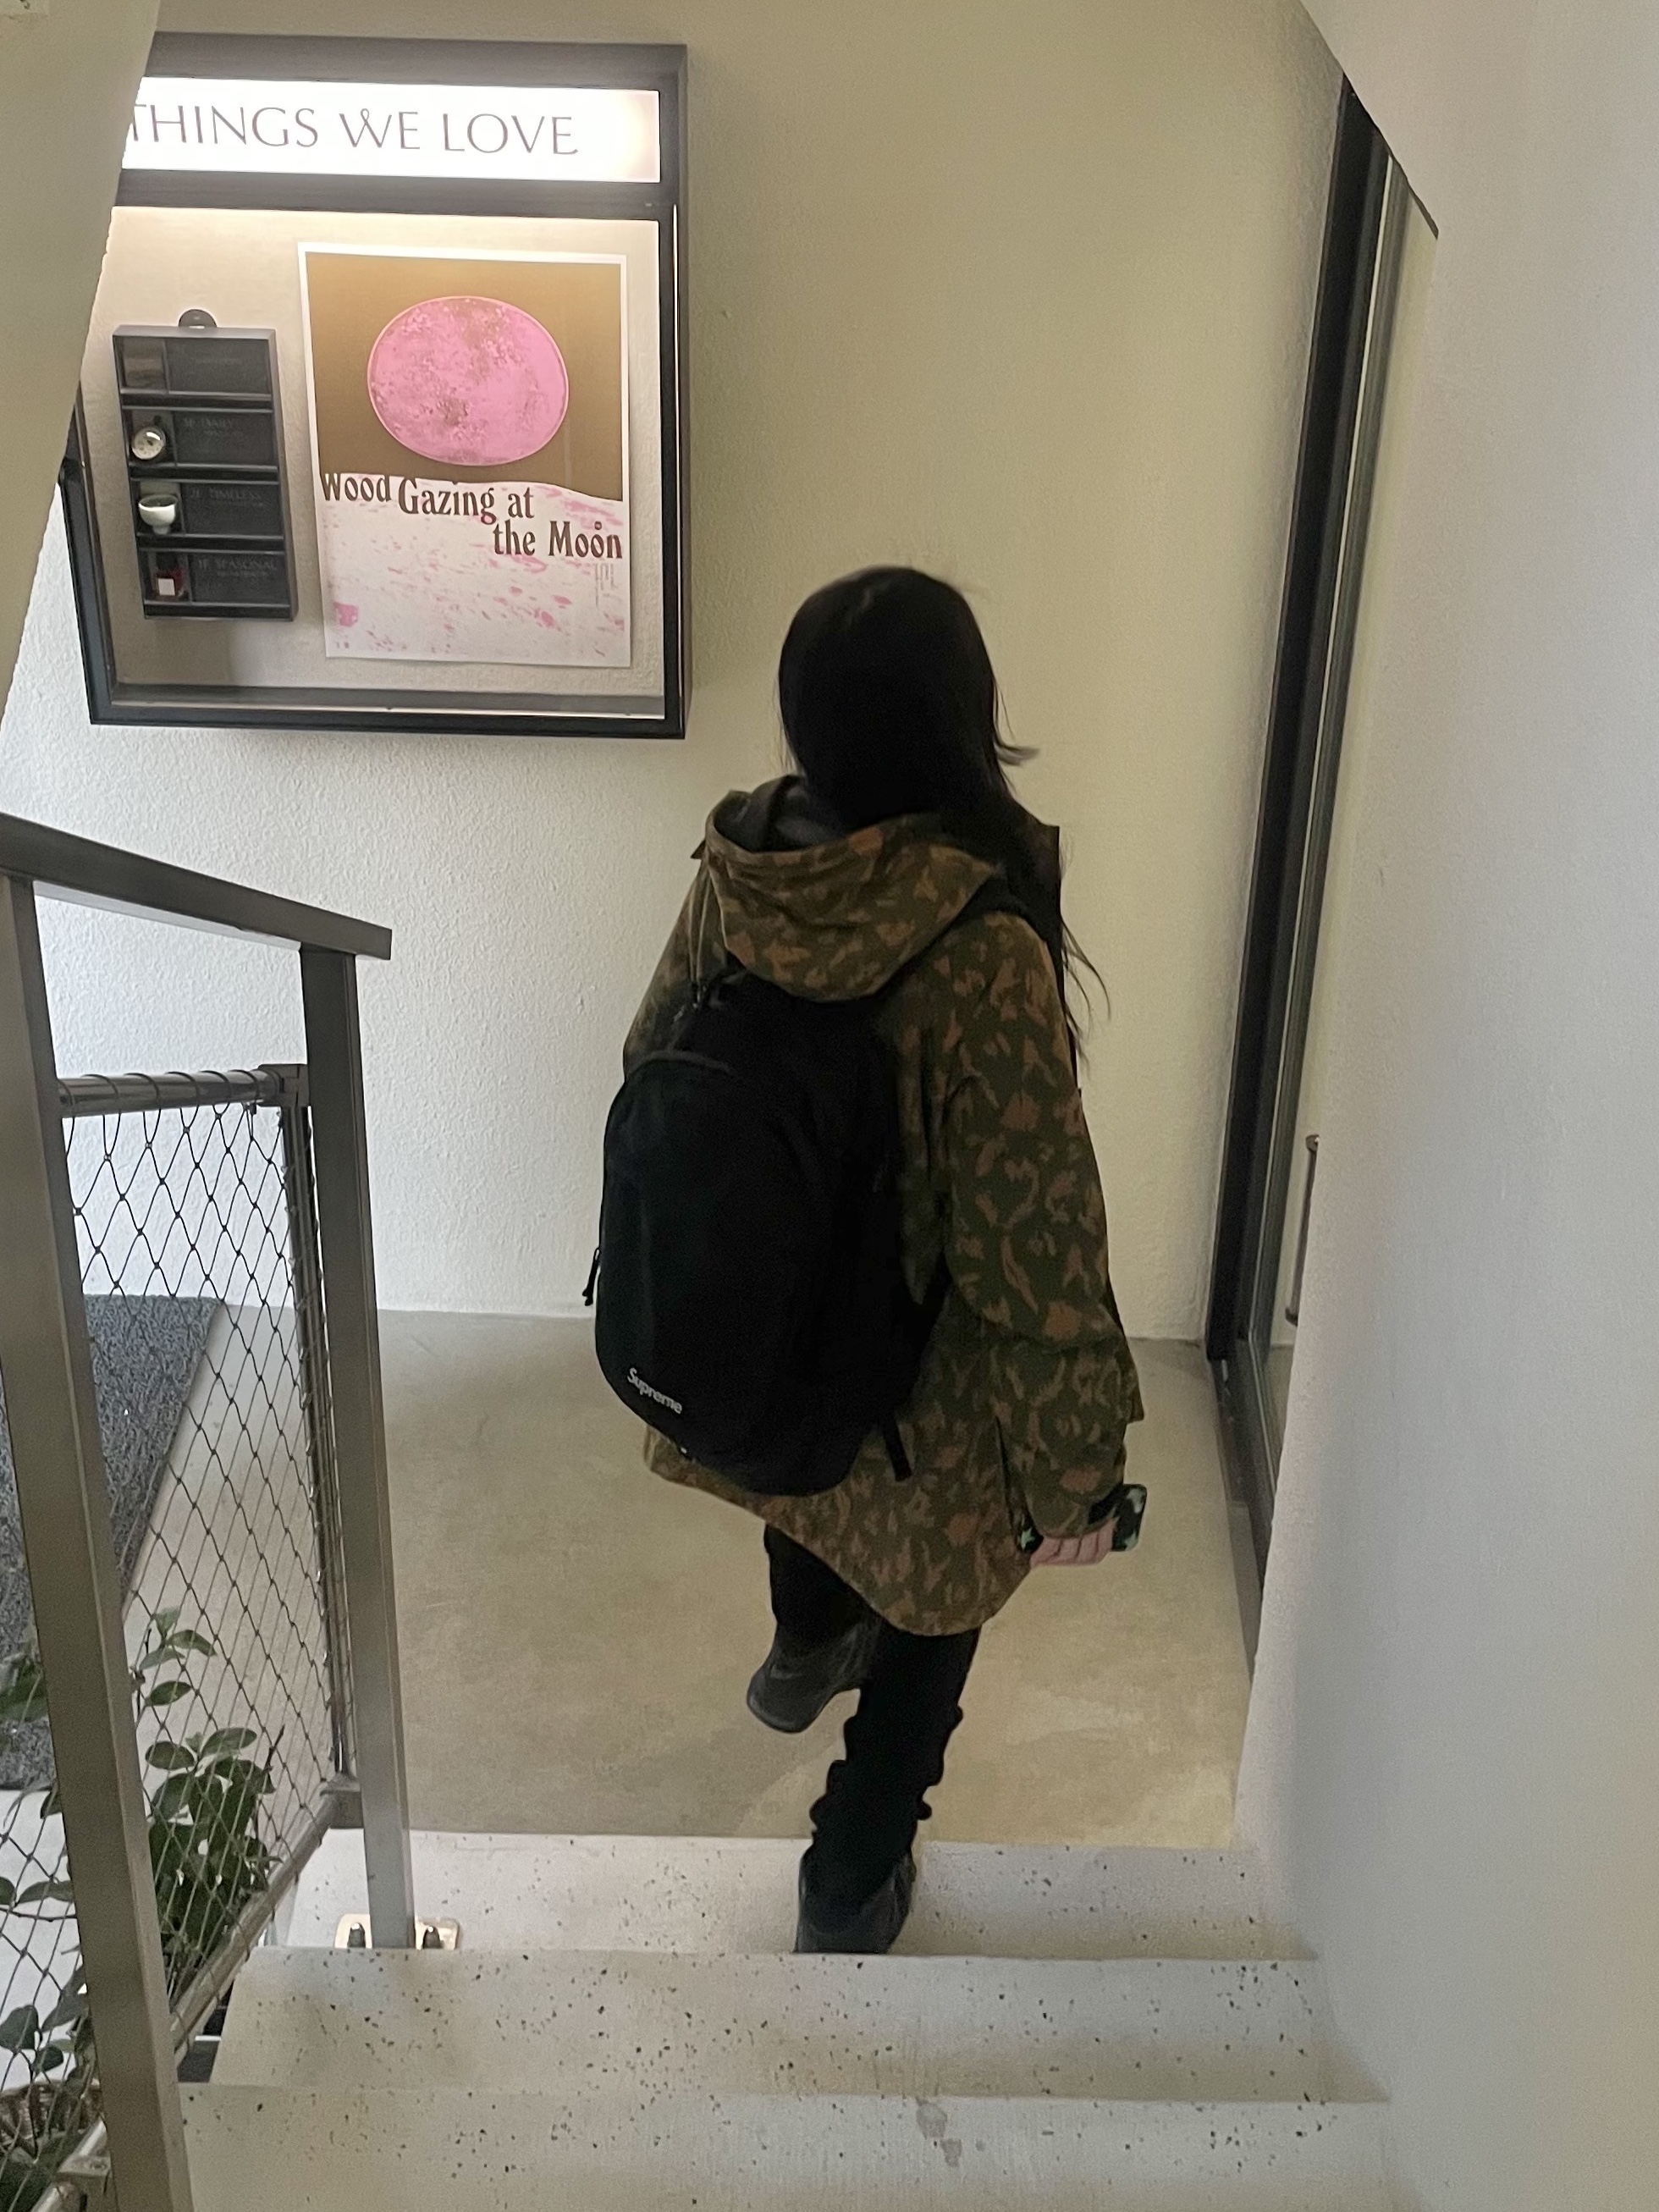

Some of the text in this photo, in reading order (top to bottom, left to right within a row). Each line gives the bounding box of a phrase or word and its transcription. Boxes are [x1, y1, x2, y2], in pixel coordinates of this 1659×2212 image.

[133, 104, 579, 156] THINGS WE LOVE
[322, 472, 535, 525] Wood Gazing at
[493, 520, 536, 556] the
[626, 1367, 683, 1415] Supreme
